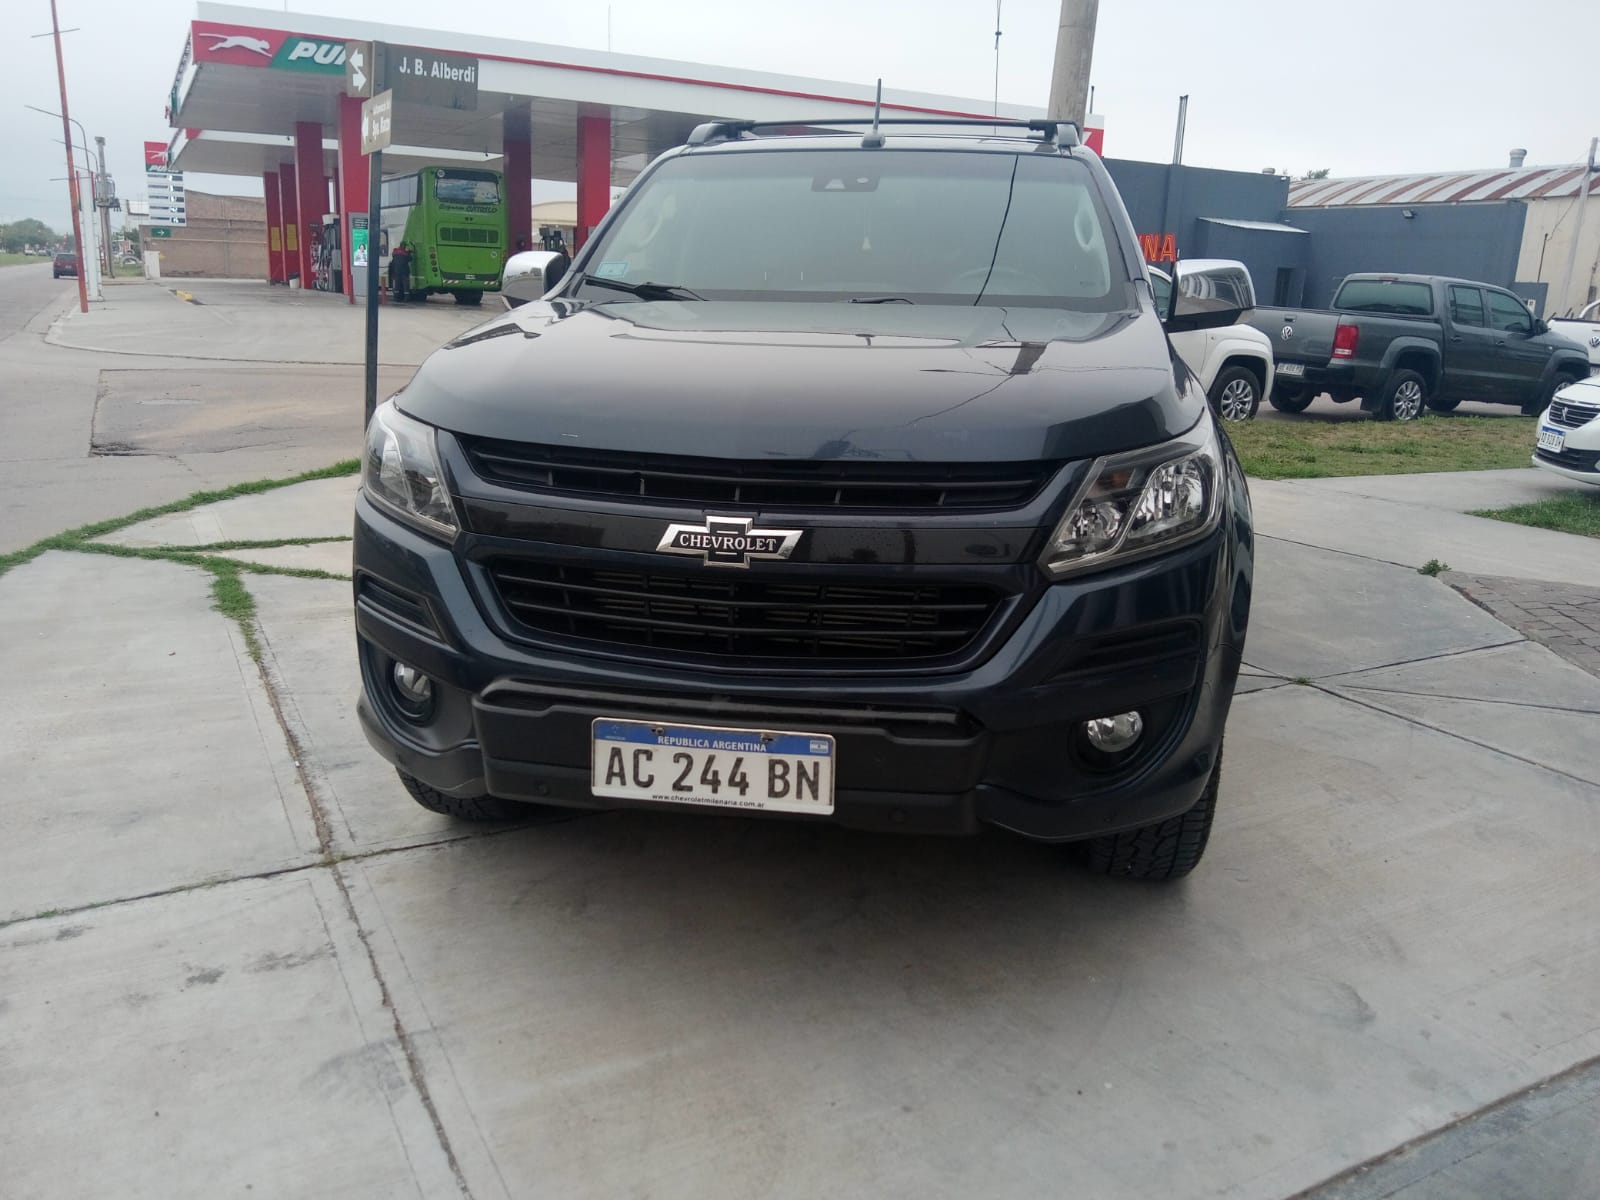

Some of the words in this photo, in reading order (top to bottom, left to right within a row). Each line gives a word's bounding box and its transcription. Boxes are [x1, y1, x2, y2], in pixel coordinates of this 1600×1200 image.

[399, 57, 410, 74] J.
[414, 58, 427, 76] B.
[430, 60, 475, 83] Alberdi
[1137, 232, 1176, 264] NA
[680, 533, 777, 552] CHEVROLET
[657, 735, 710, 748] REPUBLICA
[712, 741, 767, 752] ARGENTINA
[605, 746, 655, 788] AC
[672, 752, 750, 796] 244
[767, 758, 820, 801] BN
